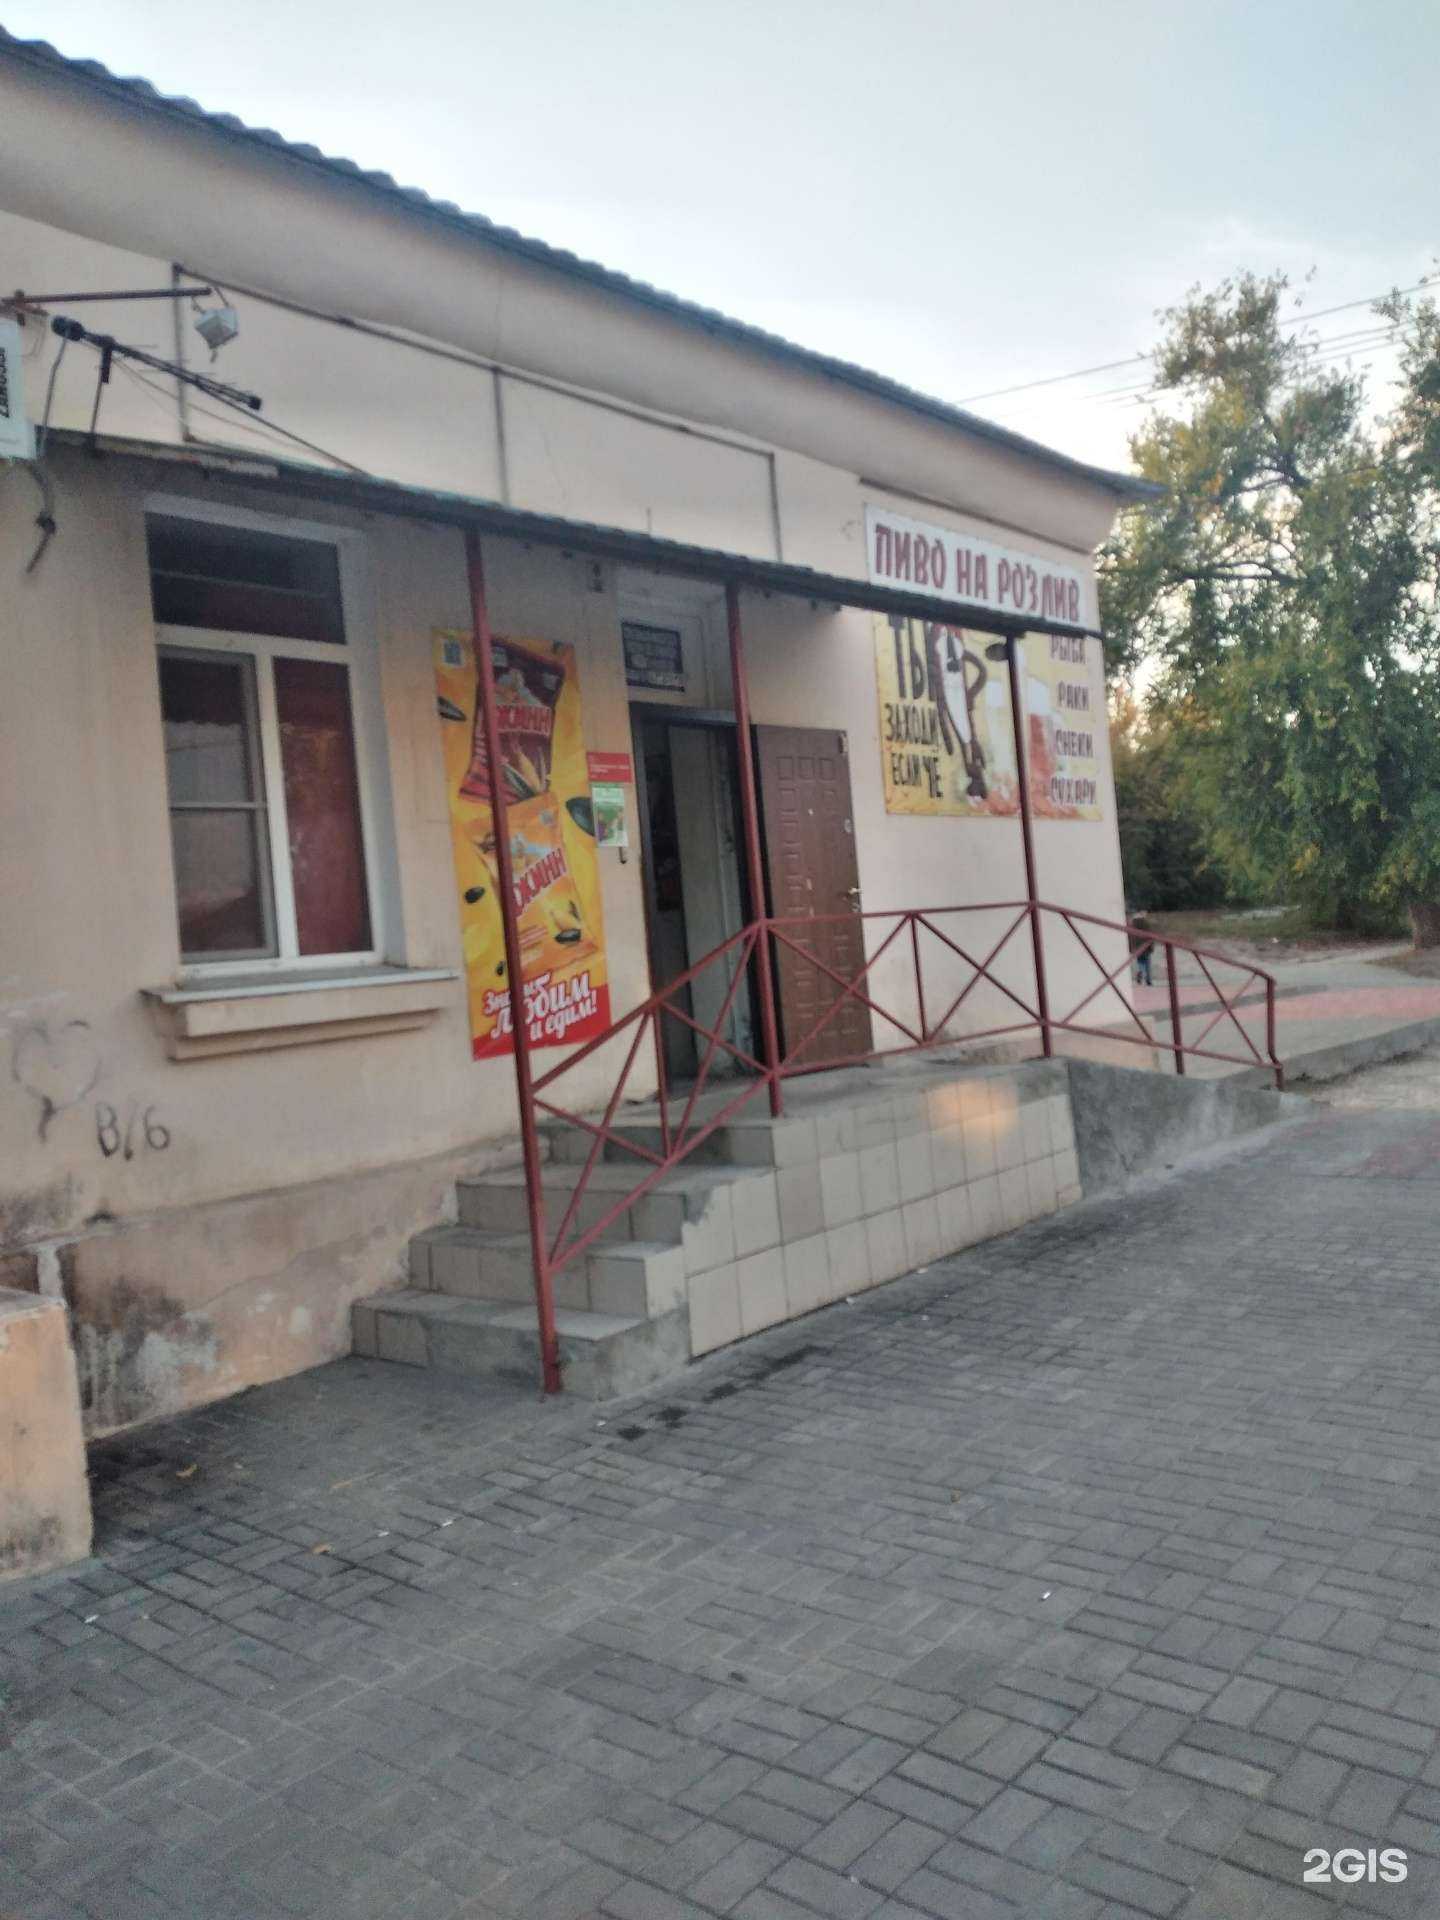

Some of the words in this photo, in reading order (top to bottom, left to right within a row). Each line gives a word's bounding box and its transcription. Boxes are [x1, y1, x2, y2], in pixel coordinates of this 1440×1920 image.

[875, 523, 948, 589] ПИВО
[956, 547, 988, 600] НА
[998, 558, 1081, 623] РОЗЛИВ
